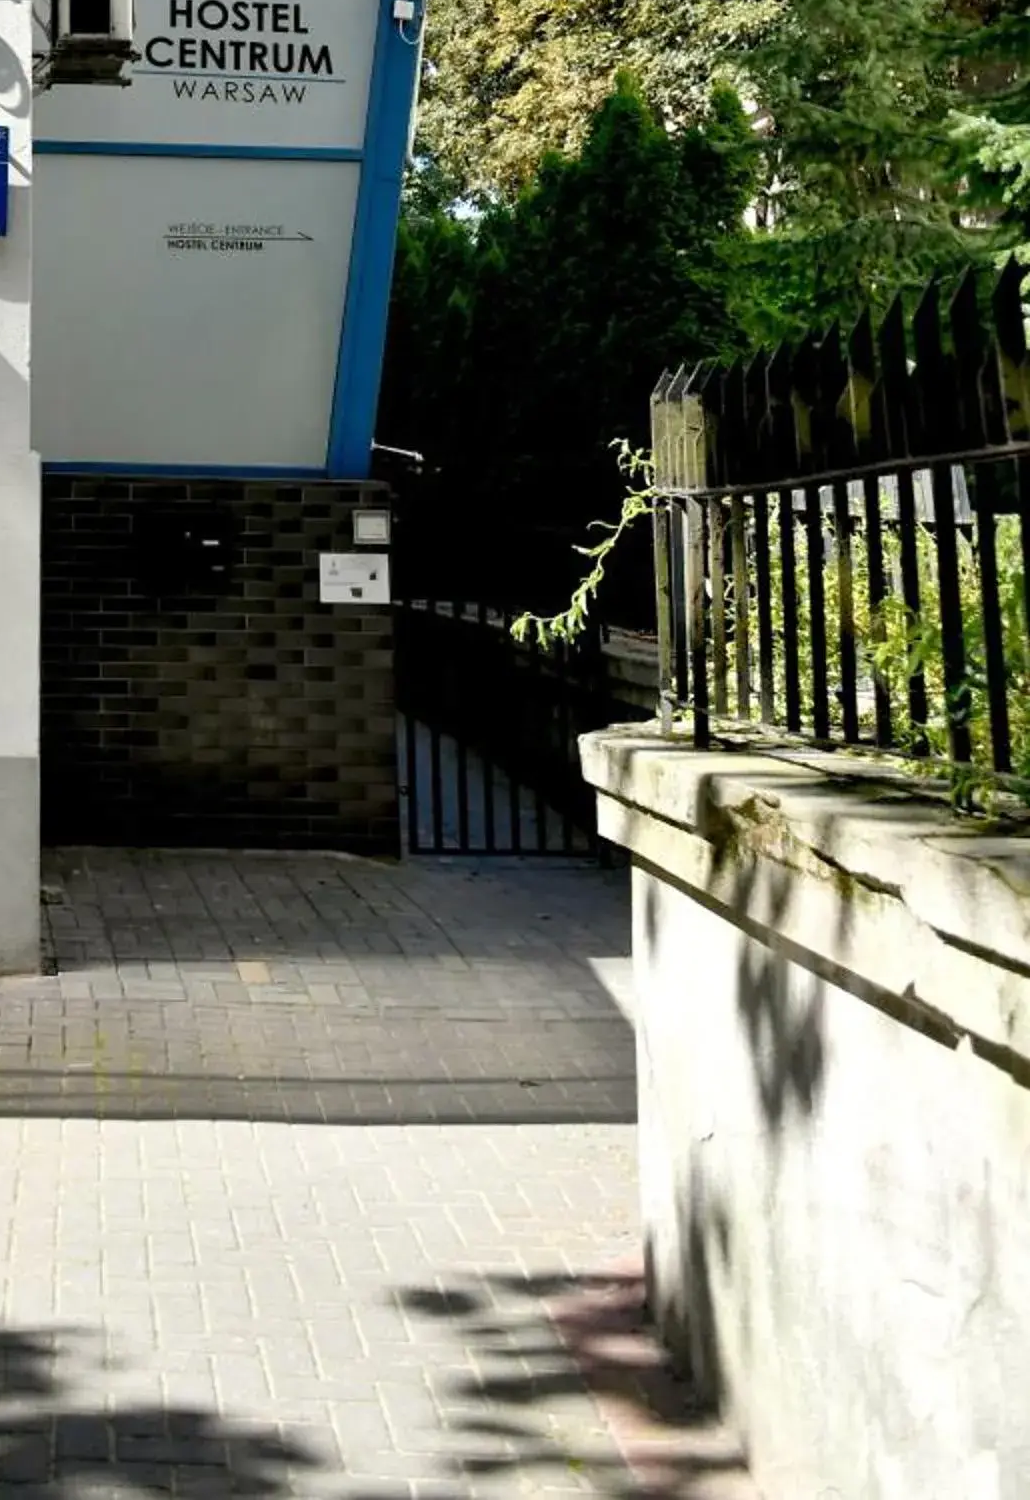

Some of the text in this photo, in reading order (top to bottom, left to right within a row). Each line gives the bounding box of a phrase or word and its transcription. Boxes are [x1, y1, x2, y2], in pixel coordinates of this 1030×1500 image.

[145, 36, 333, 75] CENTRUM
[173, 80, 307, 104] WARSAW
[167, 239, 263, 251] HOSTEL CENTRUM
